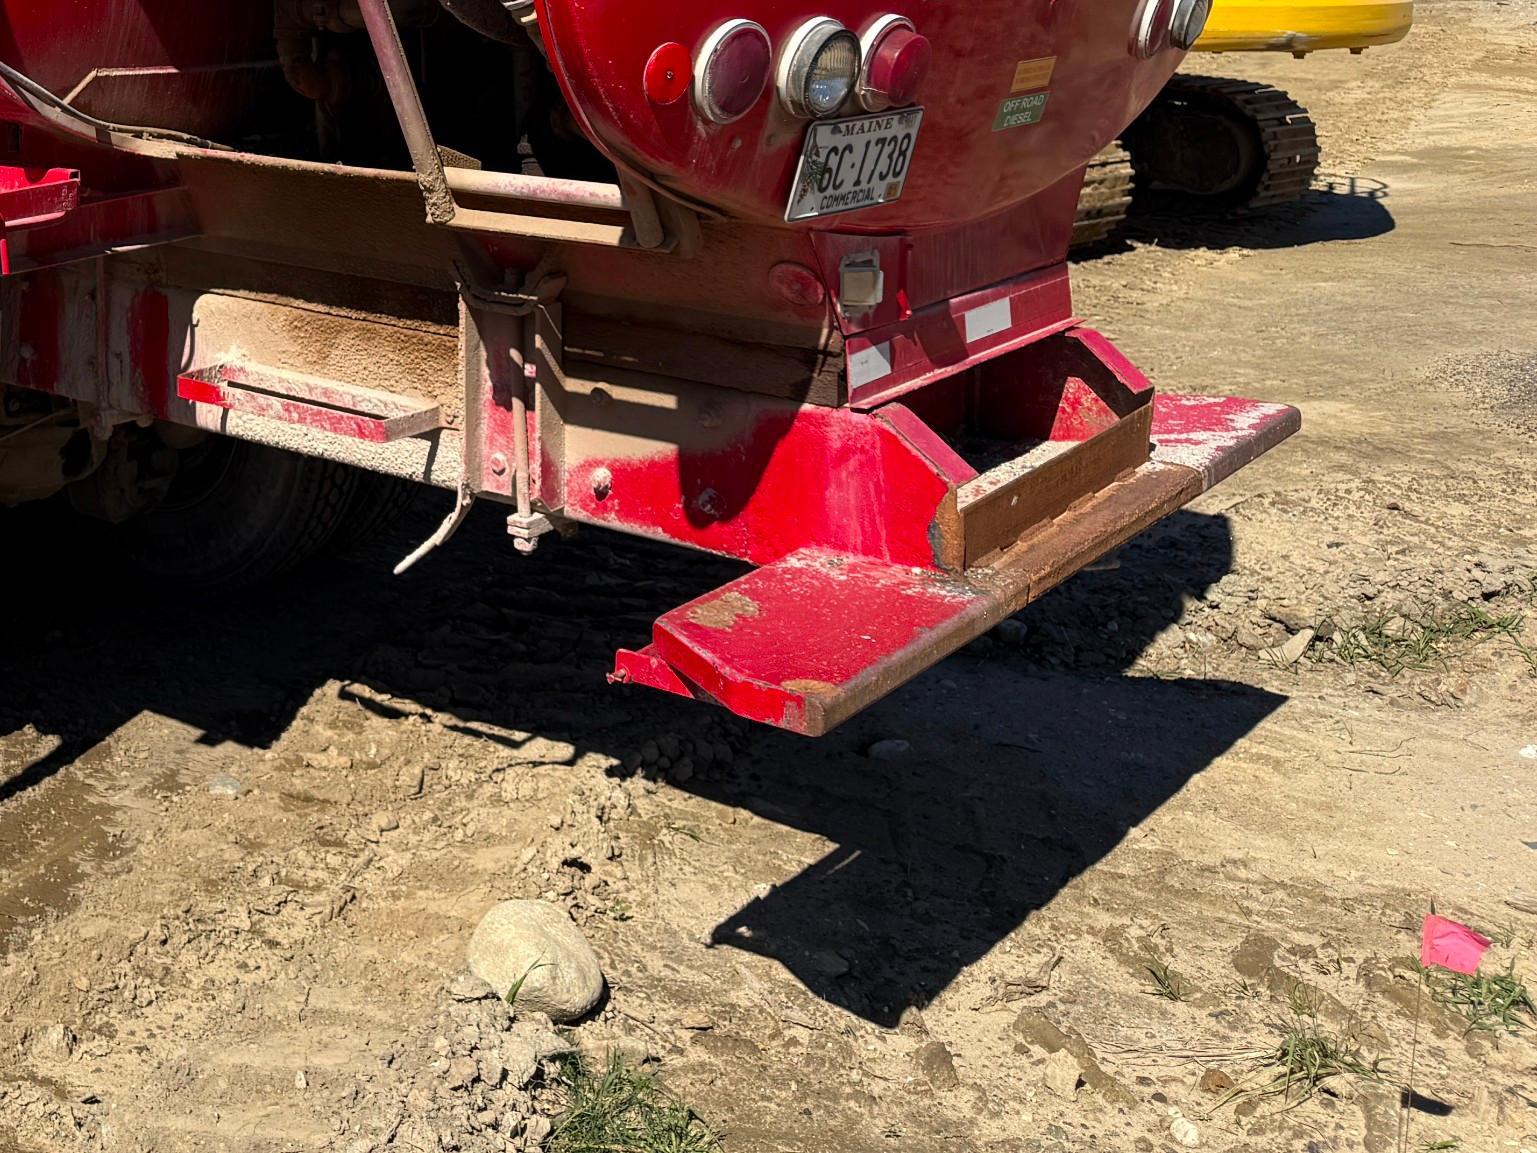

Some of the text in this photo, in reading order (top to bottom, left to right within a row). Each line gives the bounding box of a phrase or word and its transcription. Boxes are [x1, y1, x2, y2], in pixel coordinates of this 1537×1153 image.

[1004, 95, 1044, 112] OFF ROAD
[842, 117, 894, 137] MAINE
[819, 185, 876, 211] COMMERCIAL
